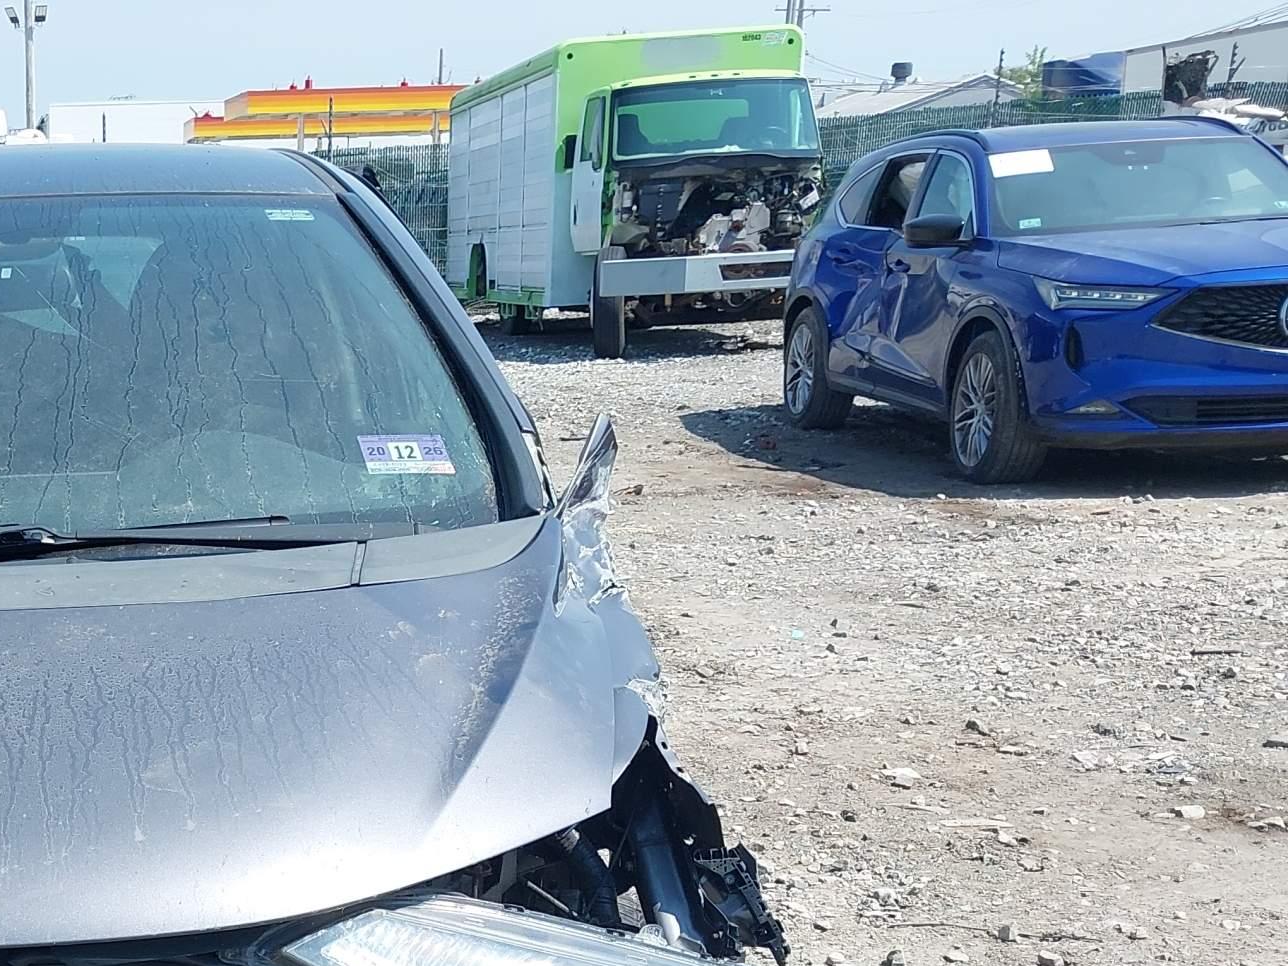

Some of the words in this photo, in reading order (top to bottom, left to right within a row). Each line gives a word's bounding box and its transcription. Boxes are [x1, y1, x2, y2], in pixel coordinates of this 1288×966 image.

[366, 446, 386, 456] 20
[393, 444, 418, 460] 12
[423, 446, 444, 456] 26
